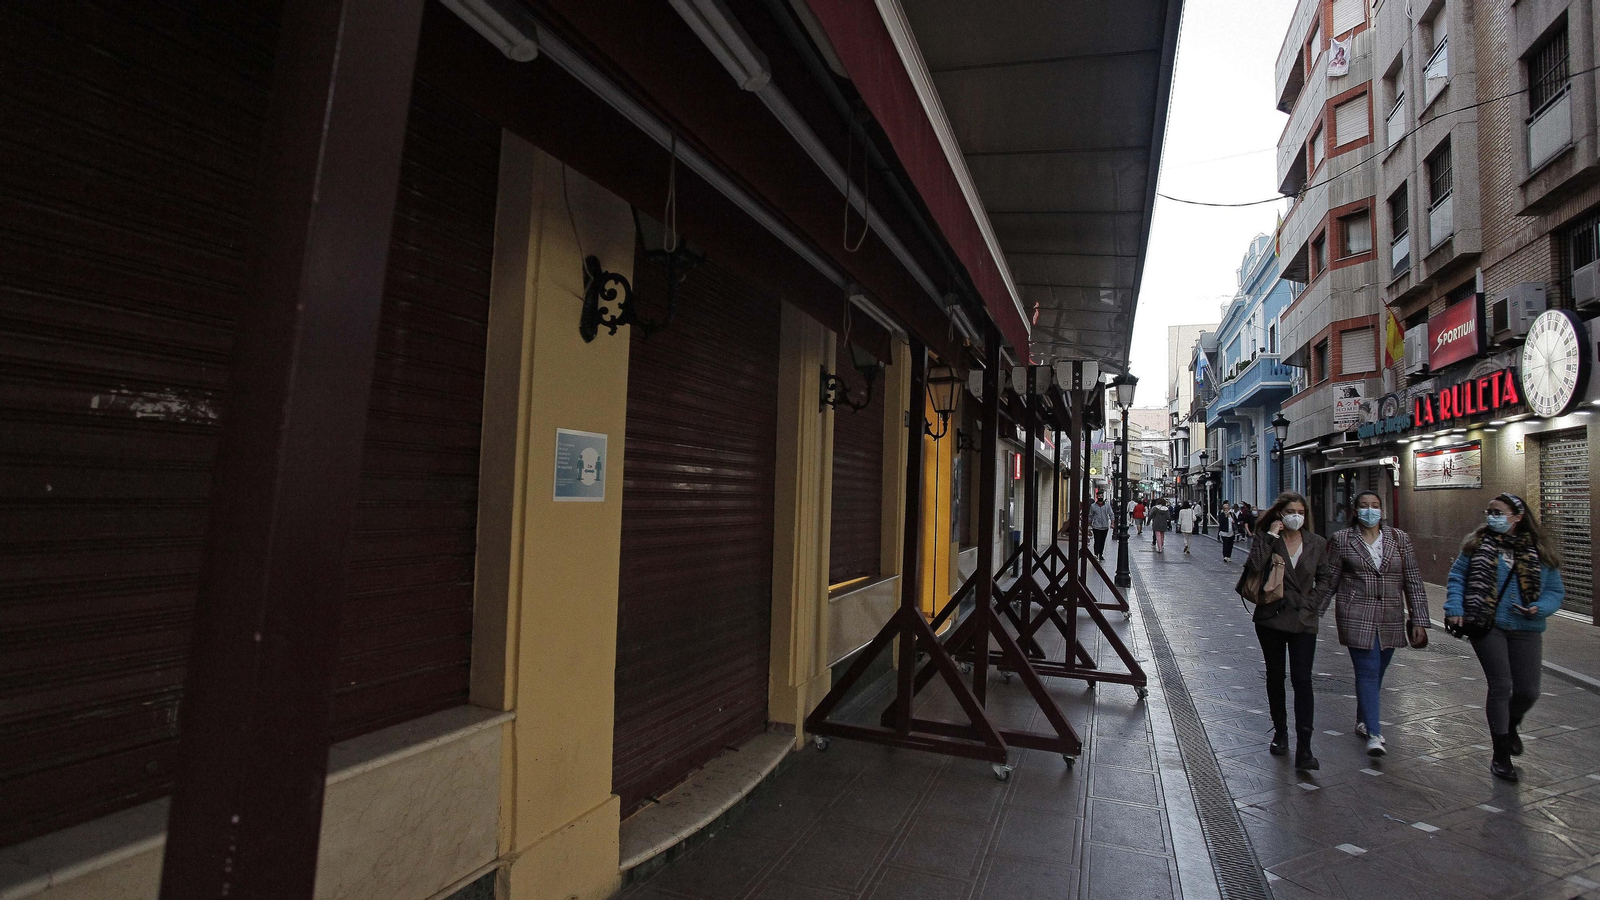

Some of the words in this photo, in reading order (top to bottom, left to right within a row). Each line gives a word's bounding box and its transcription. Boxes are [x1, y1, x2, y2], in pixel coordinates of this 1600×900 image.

[1433, 319, 1475, 354] SPORTIUM
[1414, 394, 1434, 427] LA
[1439, 367, 1519, 420] RULETA
[1385, 415, 1411, 434] Juegos
